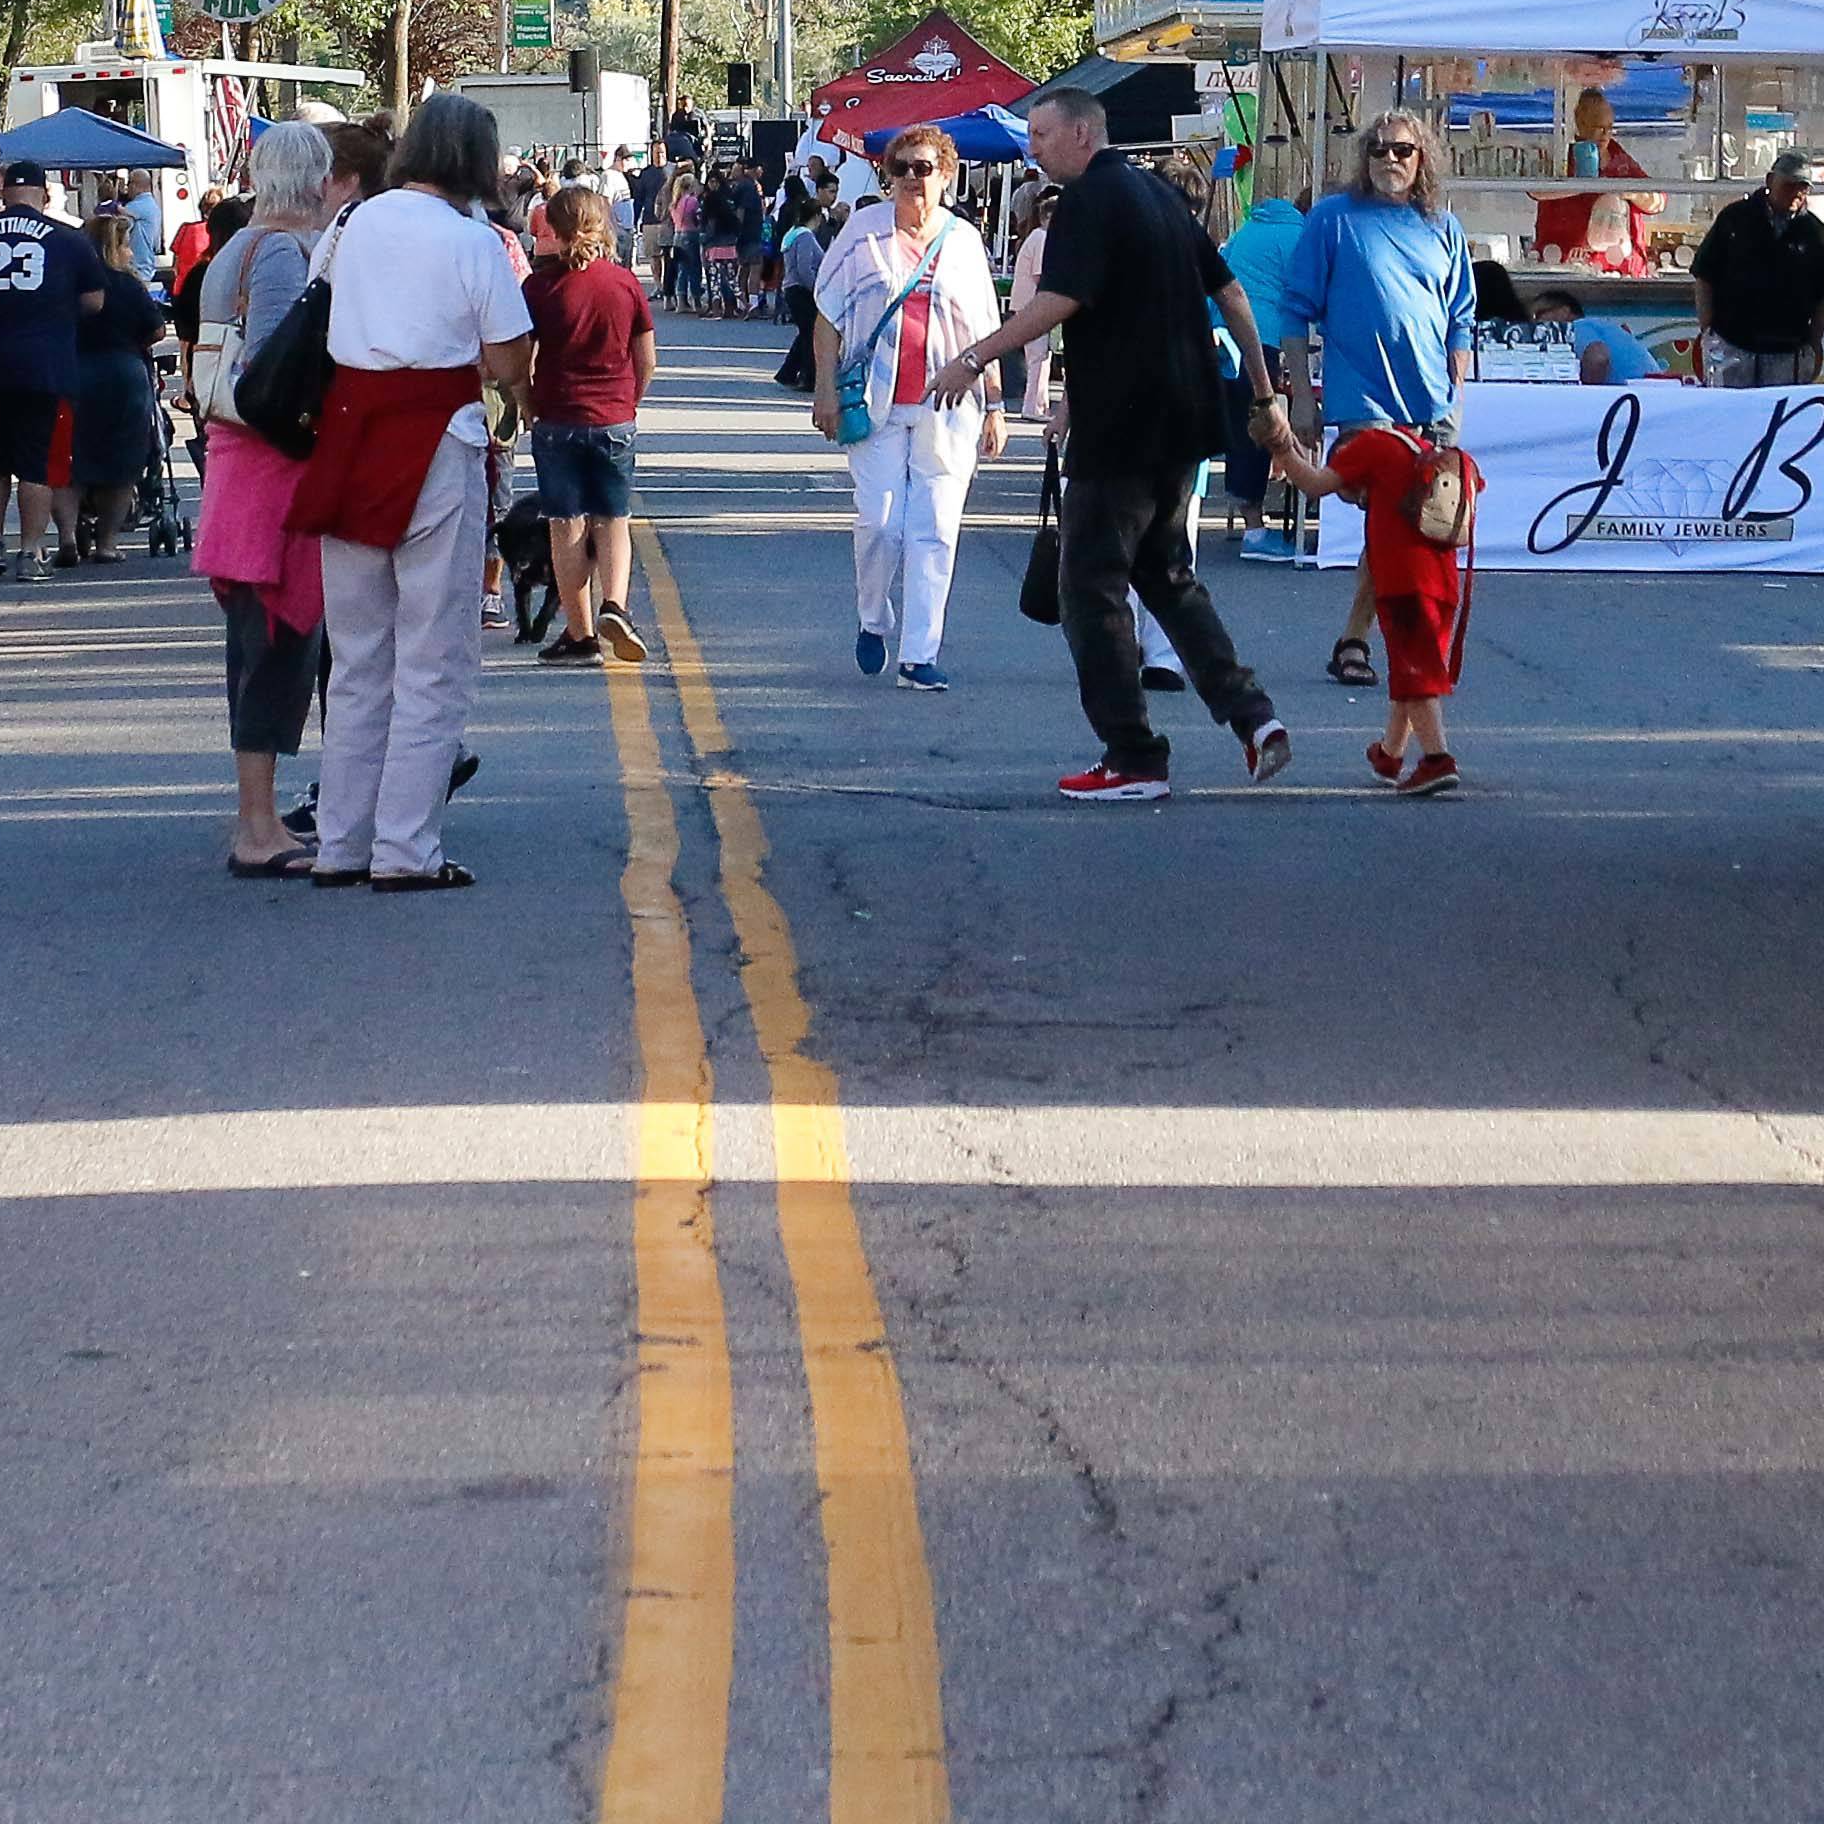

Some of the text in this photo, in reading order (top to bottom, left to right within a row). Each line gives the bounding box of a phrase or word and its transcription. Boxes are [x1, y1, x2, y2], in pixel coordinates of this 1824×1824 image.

[866, 68, 937, 85] Sacred
[1527, 393, 1641, 555] J
[1596, 522, 1768, 537] FAMILY JEWELERS
